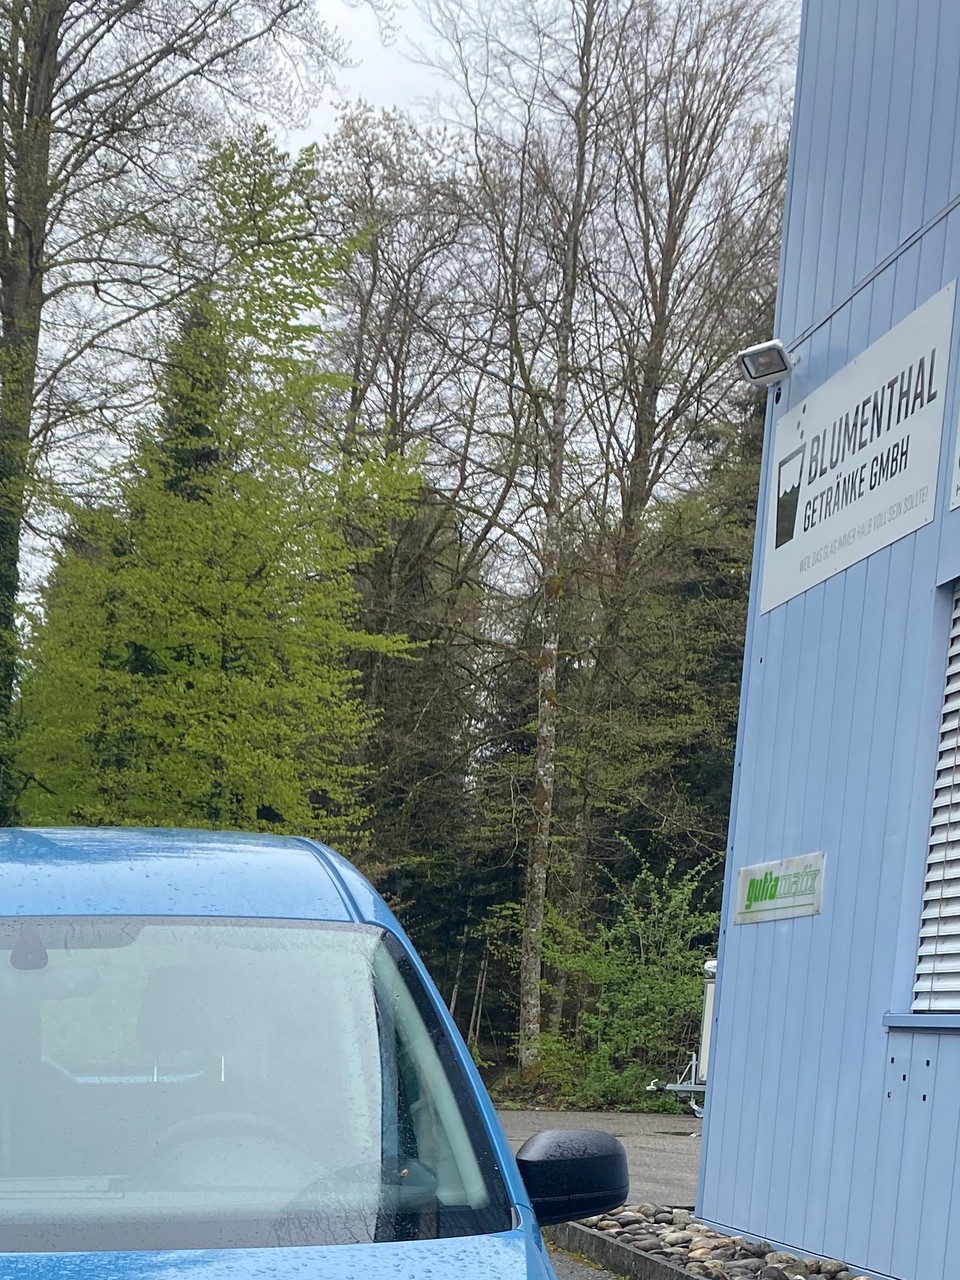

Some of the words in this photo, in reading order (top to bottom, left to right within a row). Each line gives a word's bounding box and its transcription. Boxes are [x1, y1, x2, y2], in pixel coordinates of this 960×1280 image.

[807, 347, 938, 485] BLUMENTHAL
[803, 463, 866, 533] GETRÄNKE
[870, 434, 911, 491] GMBH
[888, 501, 902, 522] SEIN
